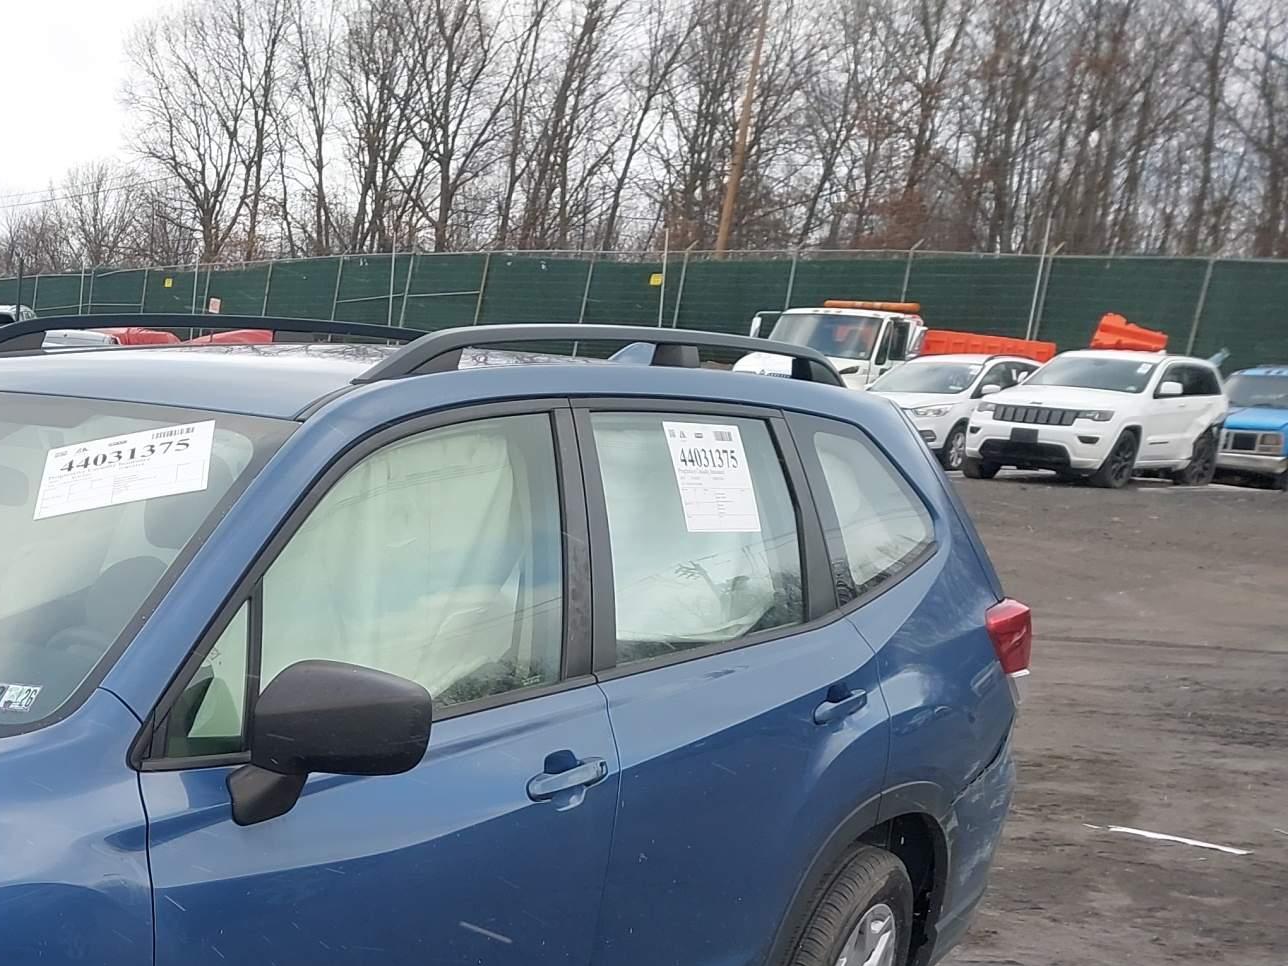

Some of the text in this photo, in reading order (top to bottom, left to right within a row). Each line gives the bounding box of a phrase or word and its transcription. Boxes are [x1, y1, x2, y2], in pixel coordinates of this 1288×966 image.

[59, 437, 191, 473] 44031375
[680, 447, 738, 468] 44031375
[19, 688, 38, 708] 26
